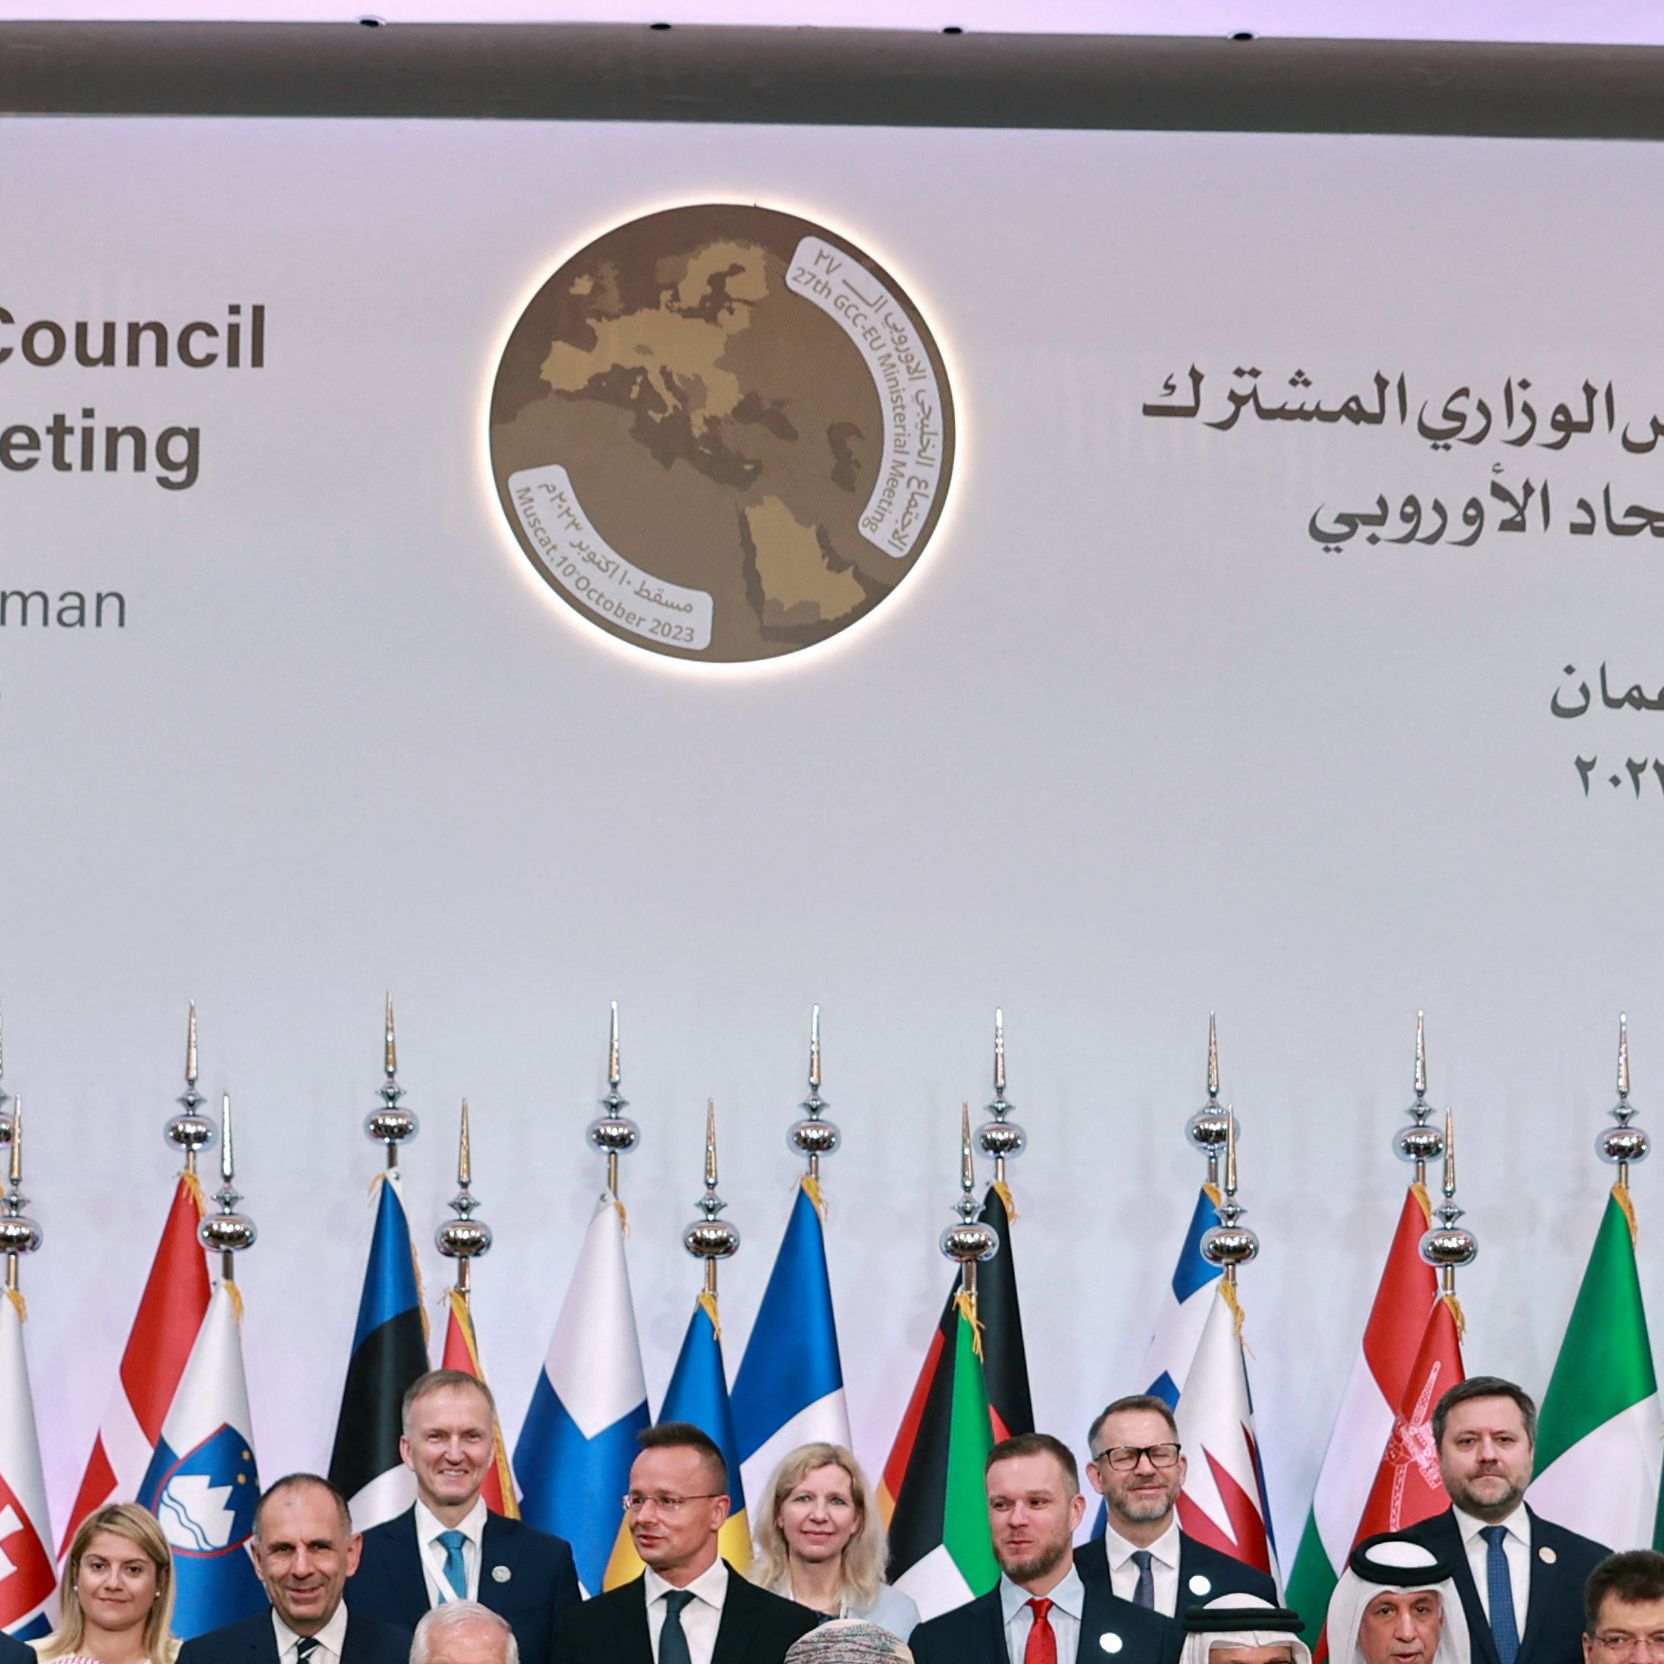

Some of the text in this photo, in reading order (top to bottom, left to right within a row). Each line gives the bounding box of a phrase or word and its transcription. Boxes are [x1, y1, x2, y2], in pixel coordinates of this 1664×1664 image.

[792, 267, 909, 534] 27th GCC-EU Ministerial Meeting
[1141, 363, 1408, 432] المشترك
[1416, 376, 1615, 452] الوزاري
[887, 475, 930, 552] الاجتماع
[910, 389, 939, 468] الخليجي
[1308, 462, 1551, 554] الأوروبي
[575, 576, 646, 628] October
[649, 618, 695, 643] 2023
[633, 581, 694, 614] مسقط
